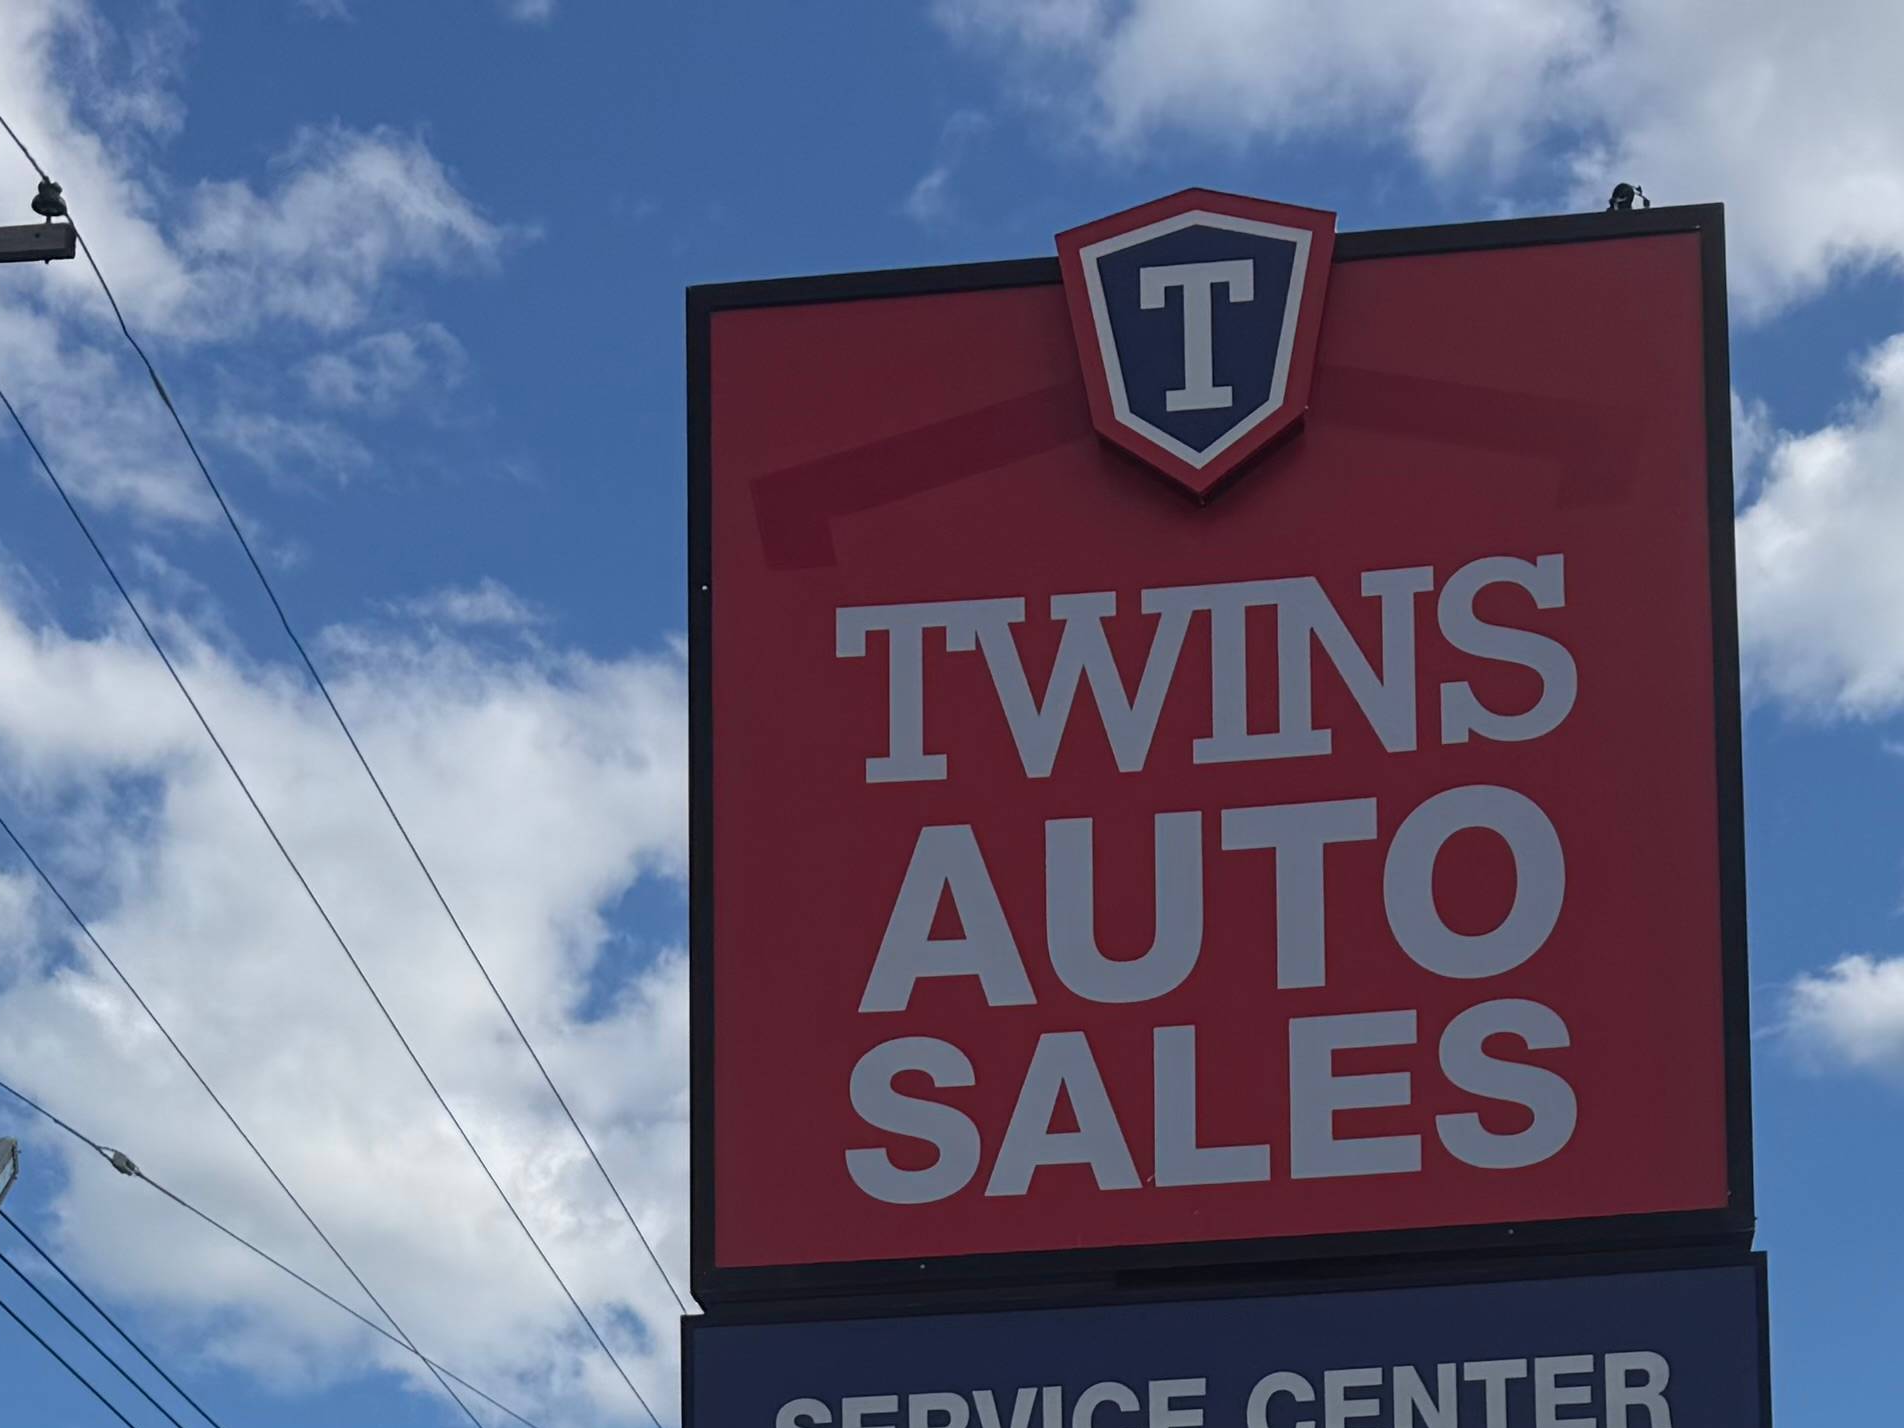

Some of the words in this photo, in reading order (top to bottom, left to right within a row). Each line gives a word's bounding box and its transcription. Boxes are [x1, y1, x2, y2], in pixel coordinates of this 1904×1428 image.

[1139, 258, 1254, 412] T
[834, 551, 1578, 784] TWINS
[857, 783, 1566, 1014] AUTO
[843, 997, 1578, 1205] SALES
